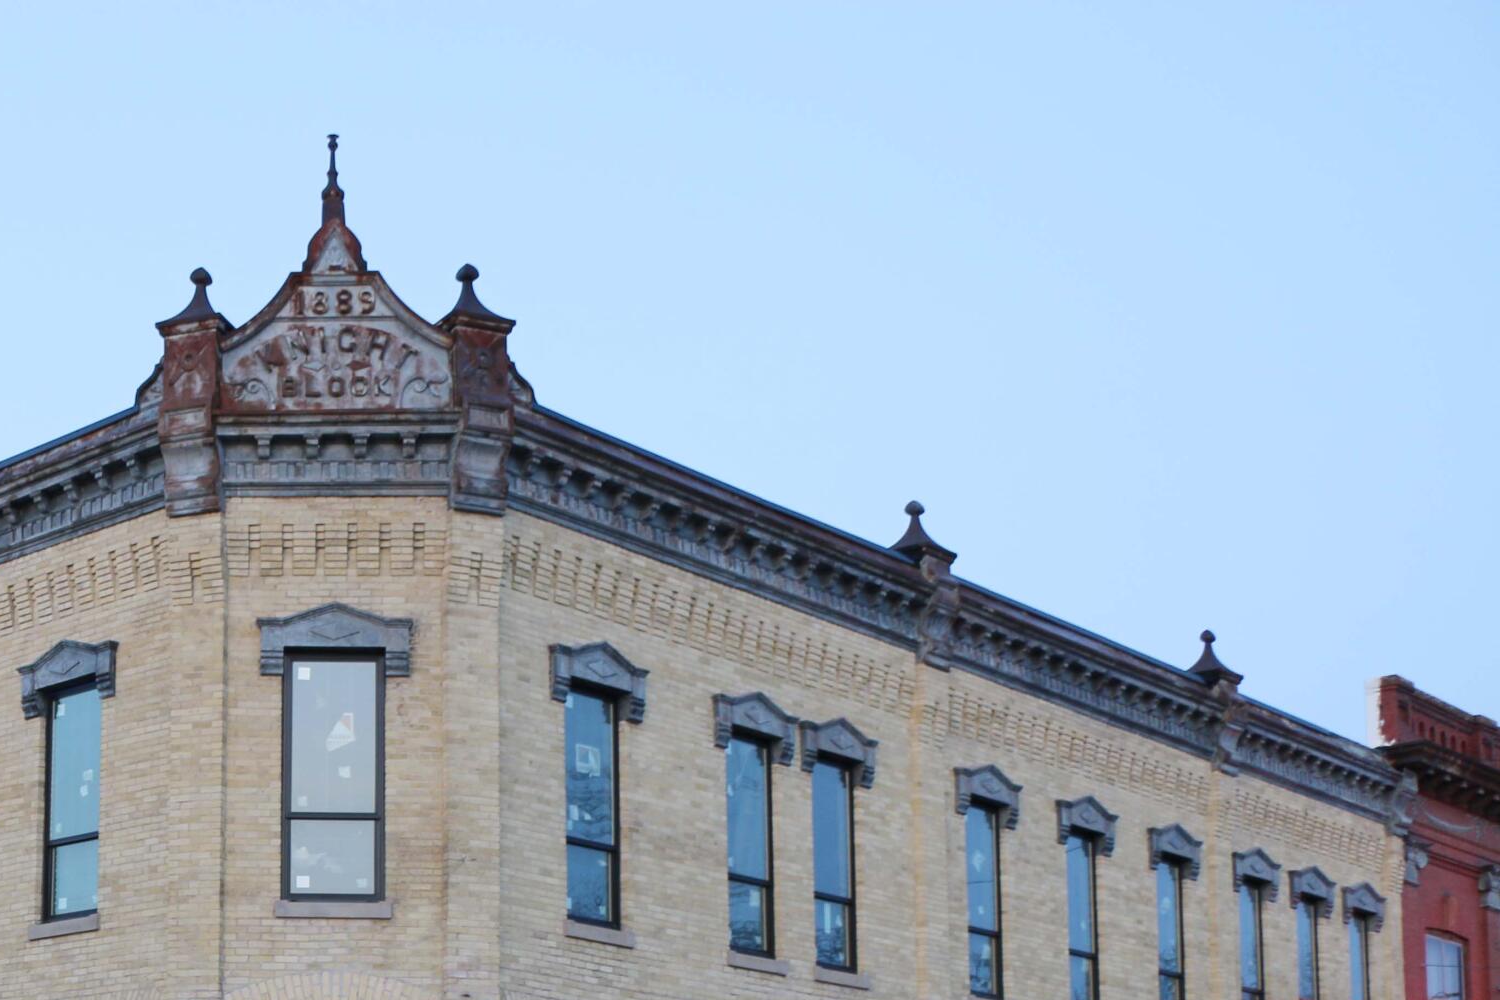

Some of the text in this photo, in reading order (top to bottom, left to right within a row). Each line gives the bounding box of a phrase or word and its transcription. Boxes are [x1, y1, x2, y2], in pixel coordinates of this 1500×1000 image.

[291, 289, 376, 316] 1889
[255, 325, 420, 373] KNIGHT
[282, 374, 393, 398] BLOCK
